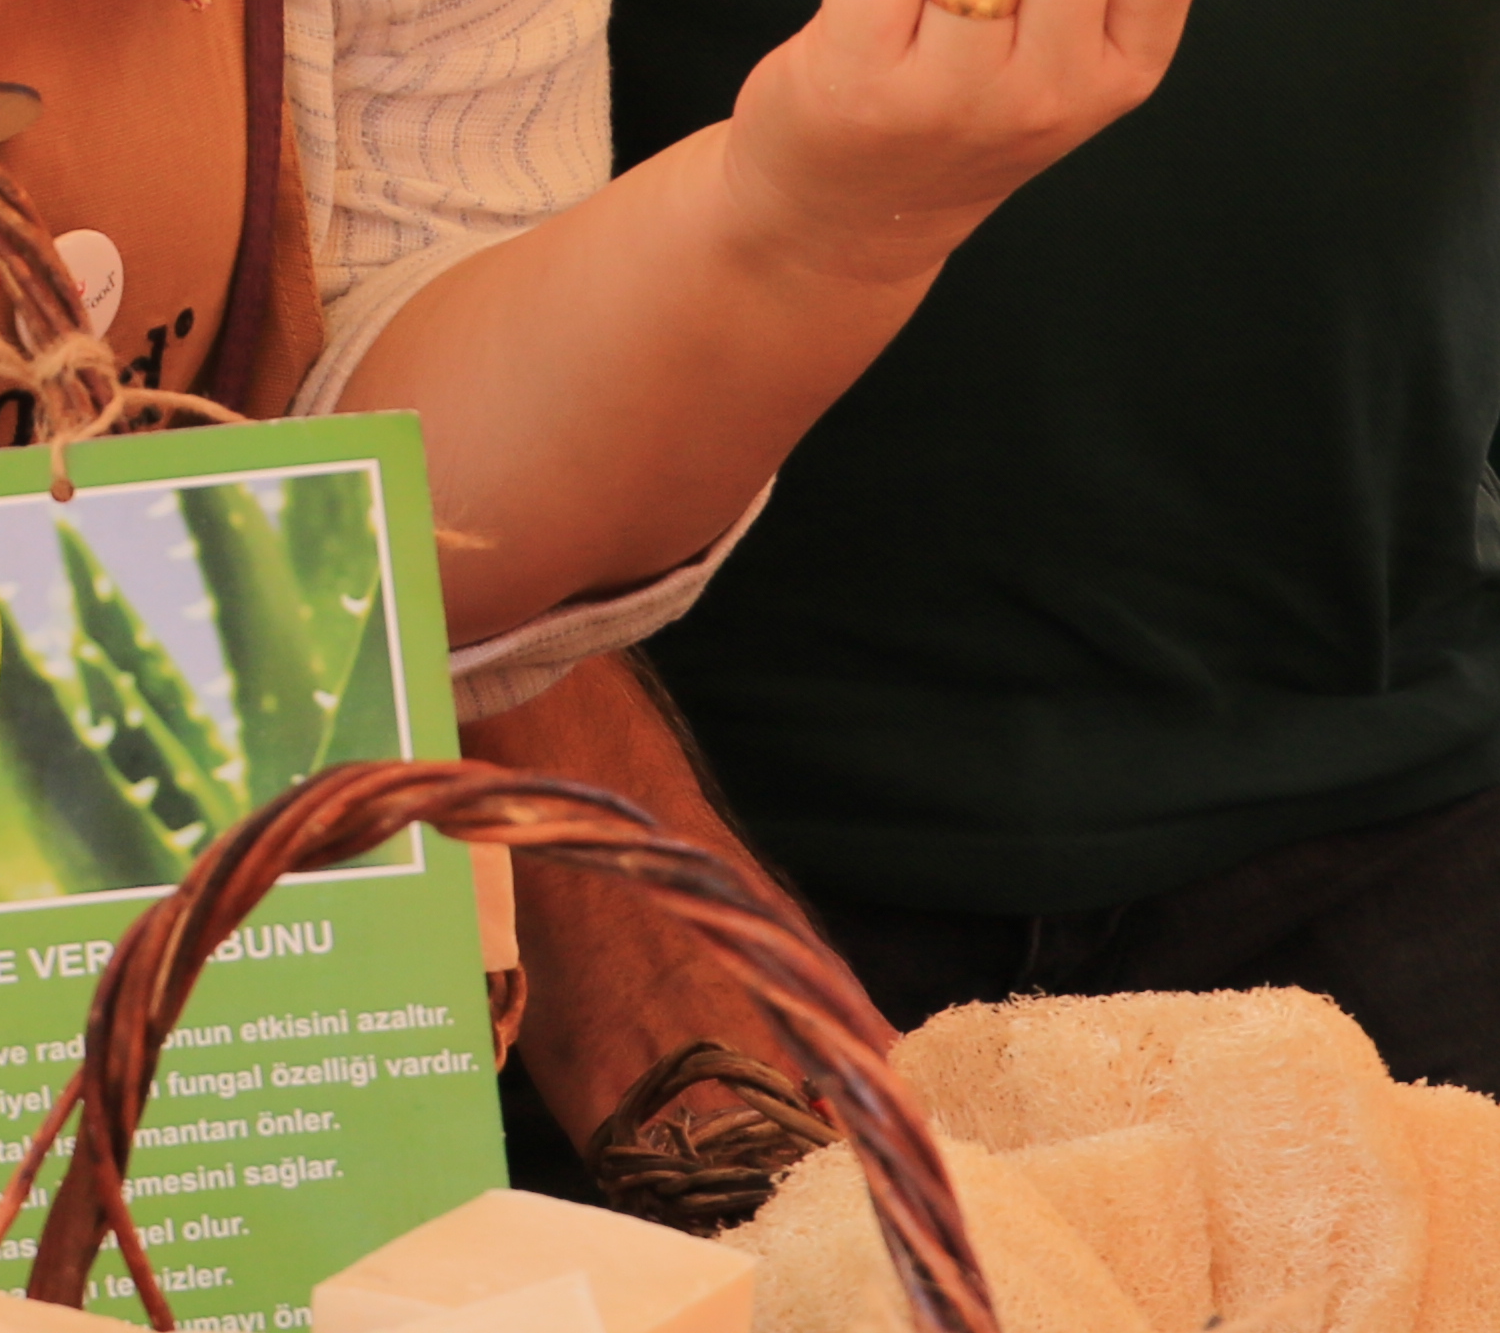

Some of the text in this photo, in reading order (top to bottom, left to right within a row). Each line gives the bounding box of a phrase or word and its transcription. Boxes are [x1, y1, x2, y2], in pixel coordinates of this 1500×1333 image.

[27, 940, 115, 979] VER
[206, 920, 334, 963] BUNU
[240, 1009, 349, 1044] etkisini
[356, 1003, 454, 1032] azaltır.
[166, 1064, 263, 1099] fungal
[271, 1053, 377, 1088] özelliği
[384, 1048, 480, 1078] vardır.
[132, 1117, 249, 1149] mantarı
[256, 1106, 342, 1137] önler.
[243, 1154, 344, 1190] sağlar.
[182, 1214, 249, 1242] olur.
[105, 1264, 233, 1300] teizler.
